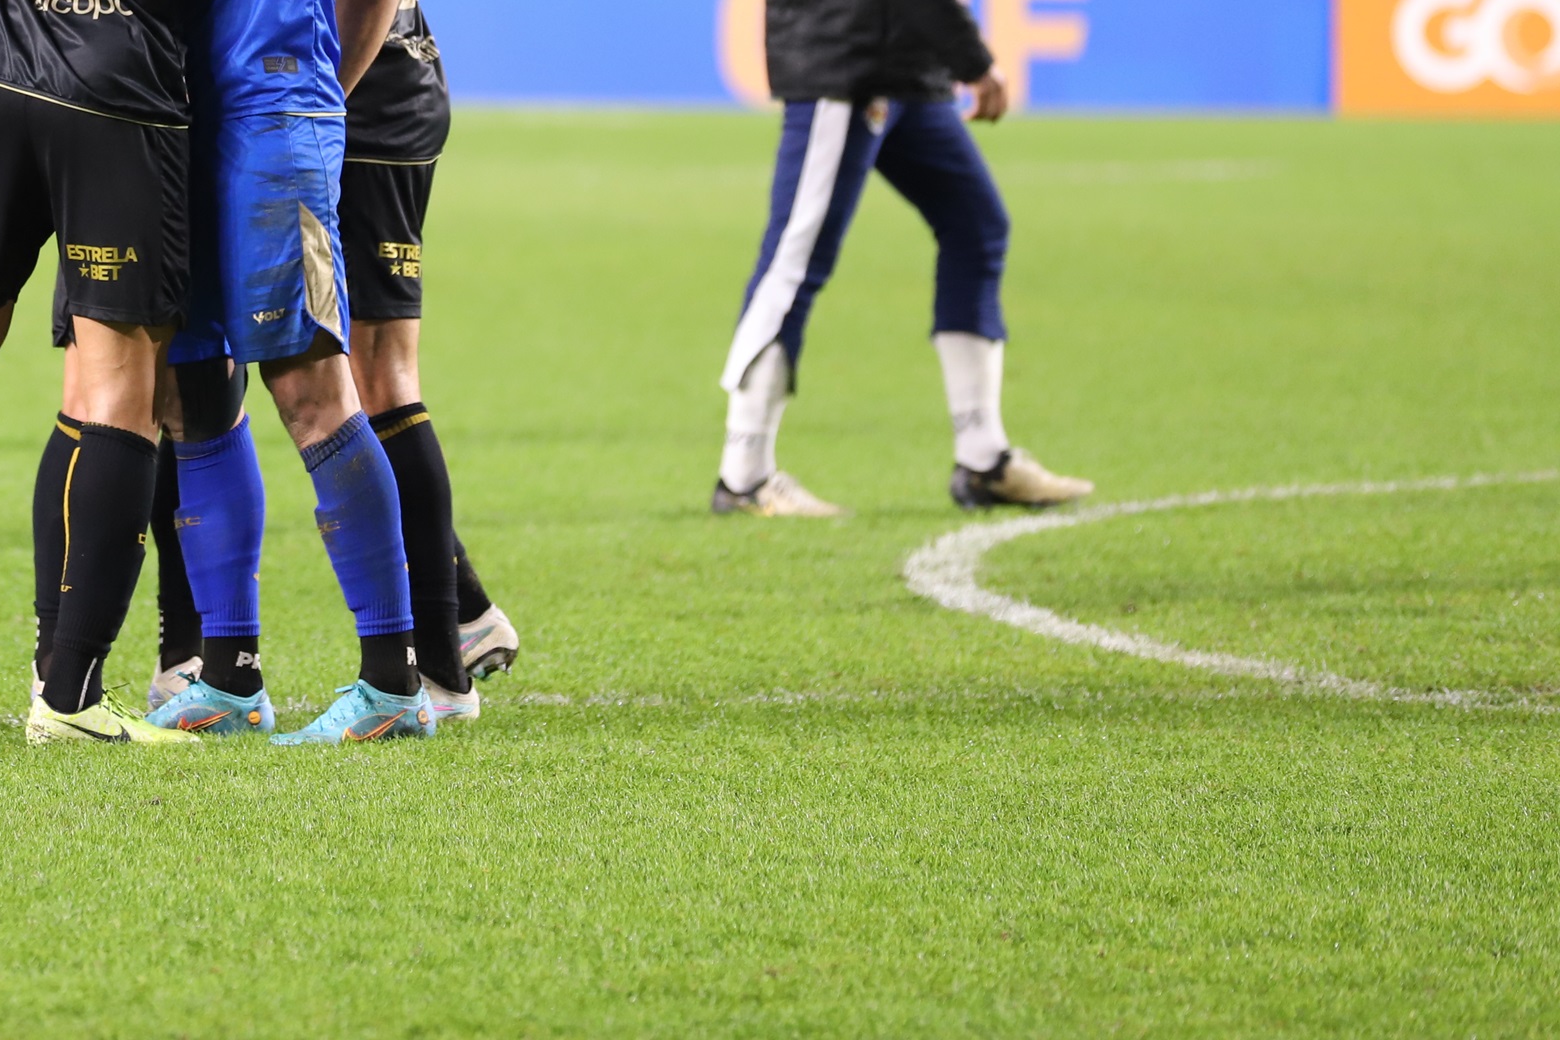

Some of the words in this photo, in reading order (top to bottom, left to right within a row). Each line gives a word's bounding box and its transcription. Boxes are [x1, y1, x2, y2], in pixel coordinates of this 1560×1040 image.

[66, 244, 138, 263] ESTRELA
[90, 264, 122, 281] BET
[252, 308, 286, 325] VOLT
